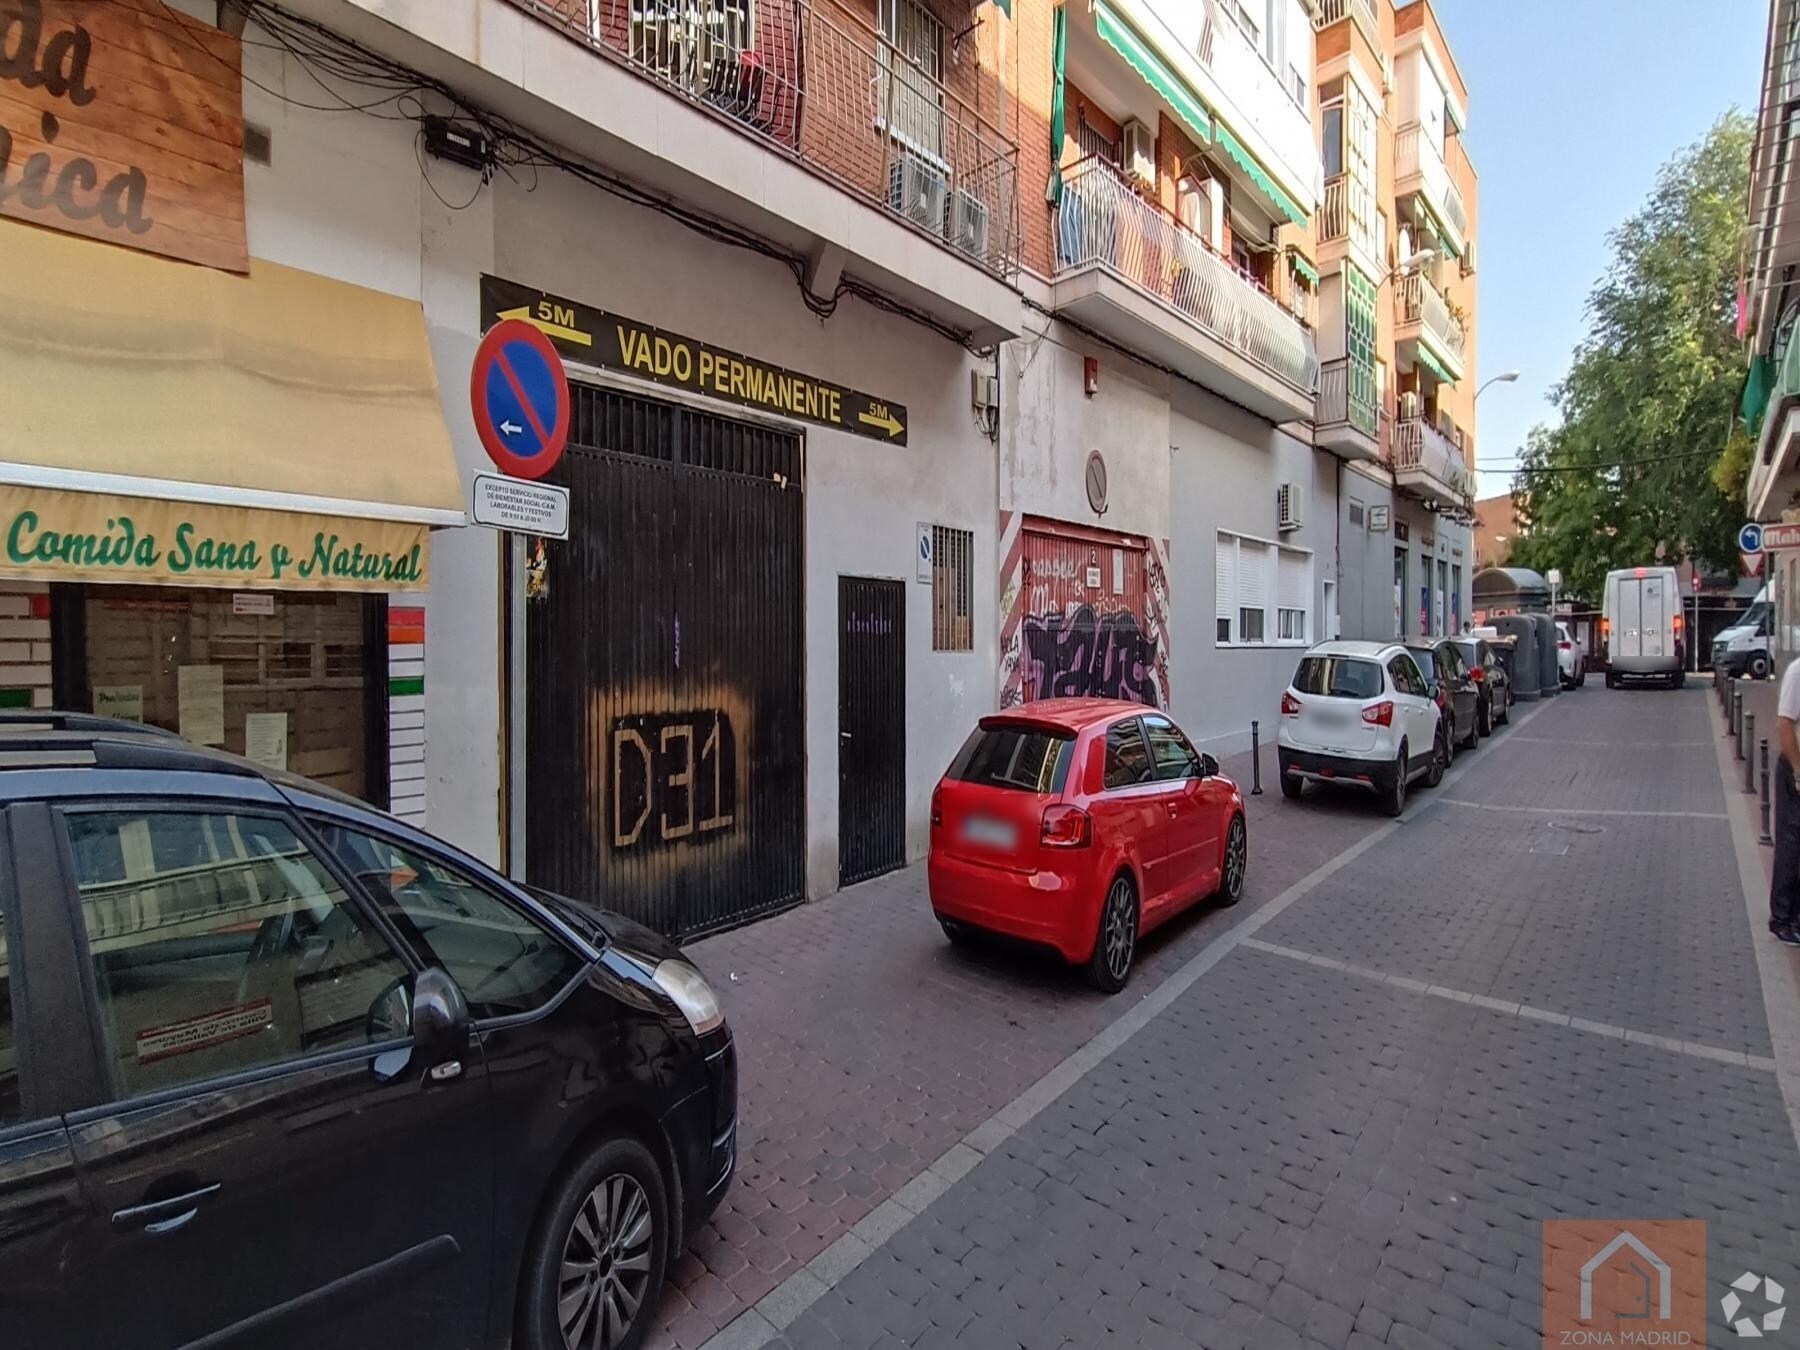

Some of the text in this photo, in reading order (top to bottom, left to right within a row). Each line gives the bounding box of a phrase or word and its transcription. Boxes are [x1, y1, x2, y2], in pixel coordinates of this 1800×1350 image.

[538, 301, 575, 328] 5M
[617, 325, 841, 423] VADO PERMANENTE
[869, 402, 888, 420] 5M
[485, 483, 557, 503] EXCEPTO SERVICIO REGIONAL
[495, 493, 523, 504] BIENESTAR
[523, 498, 540, 507] SOCIAL
[490, 501, 524, 512] LABORABLES
[528, 507, 552, 518] FESTIVOS
[7, 510, 422, 582] Comida Sana y Natural
[1091, 550, 1096, 564] 2
